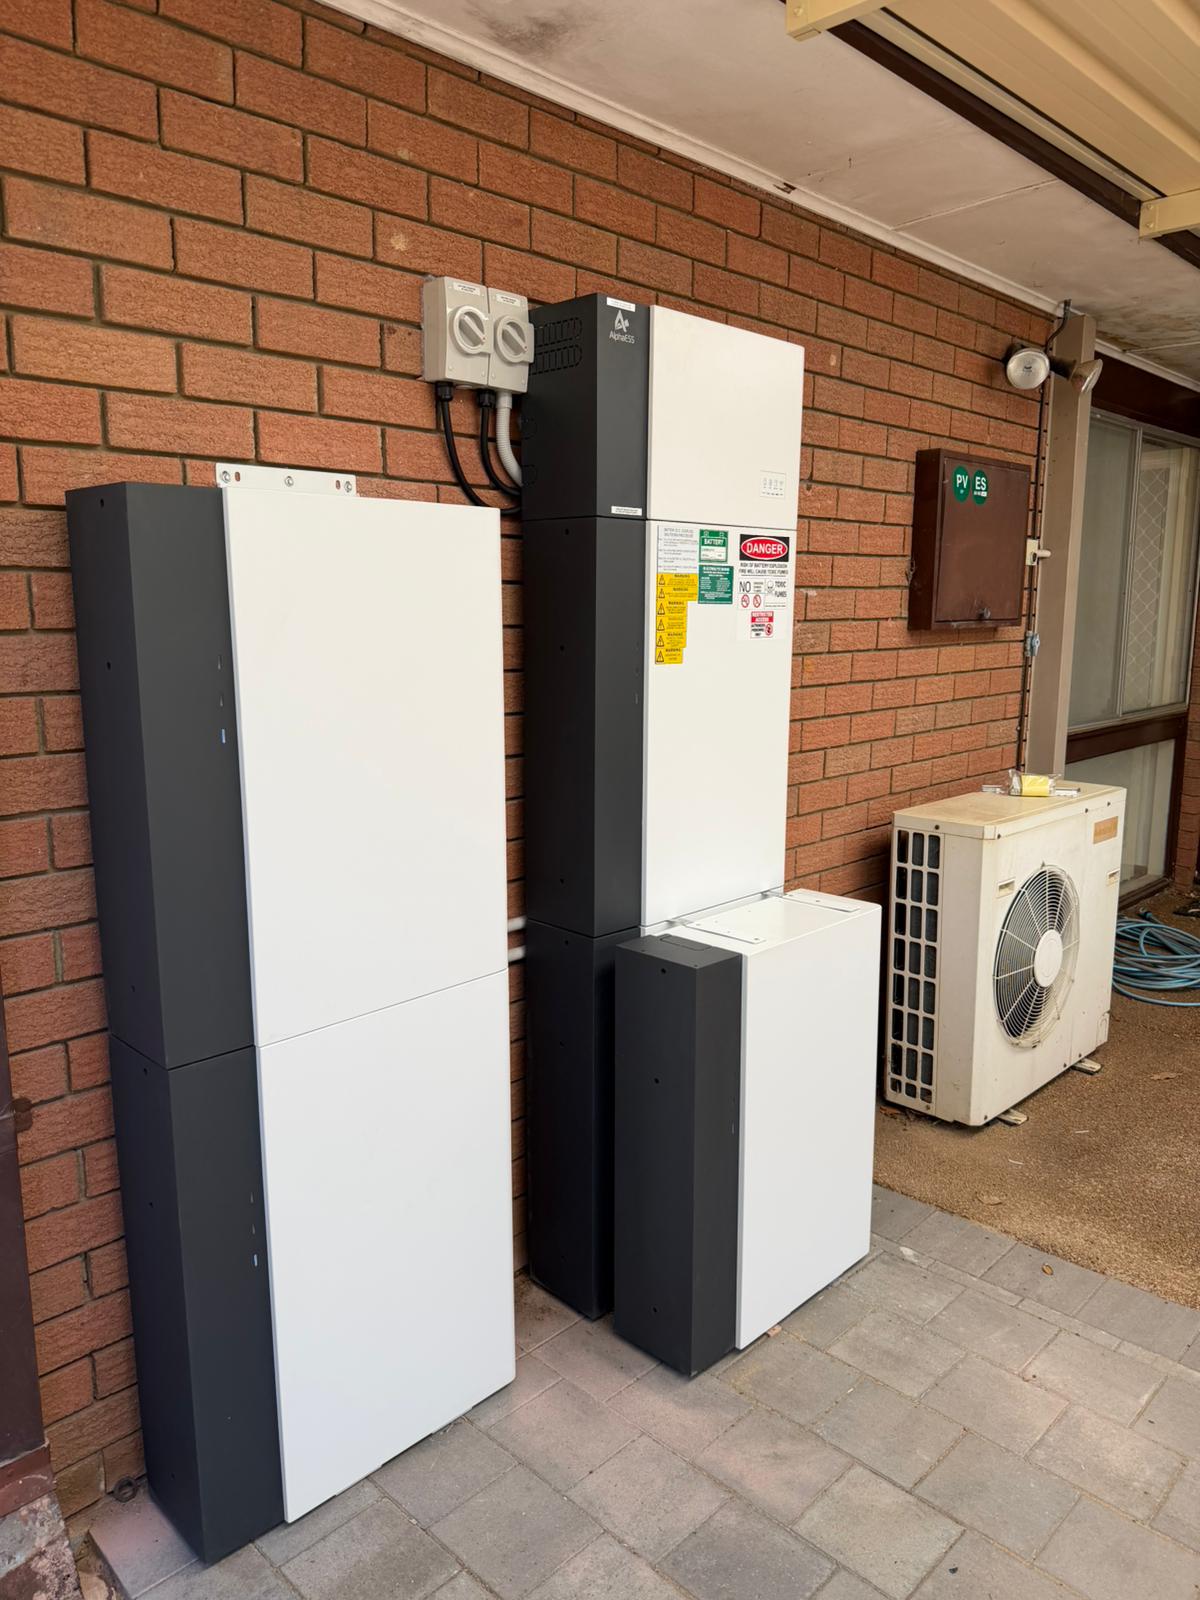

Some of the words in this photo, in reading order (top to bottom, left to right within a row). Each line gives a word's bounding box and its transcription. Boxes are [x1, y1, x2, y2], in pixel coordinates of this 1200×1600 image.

[609, 330, 635, 344] AlphaESS
[956, 474, 968, 488] PV
[975, 476, 986, 490] ES
[746, 543, 783, 554] DANGER
[739, 581, 751, 593] NO
